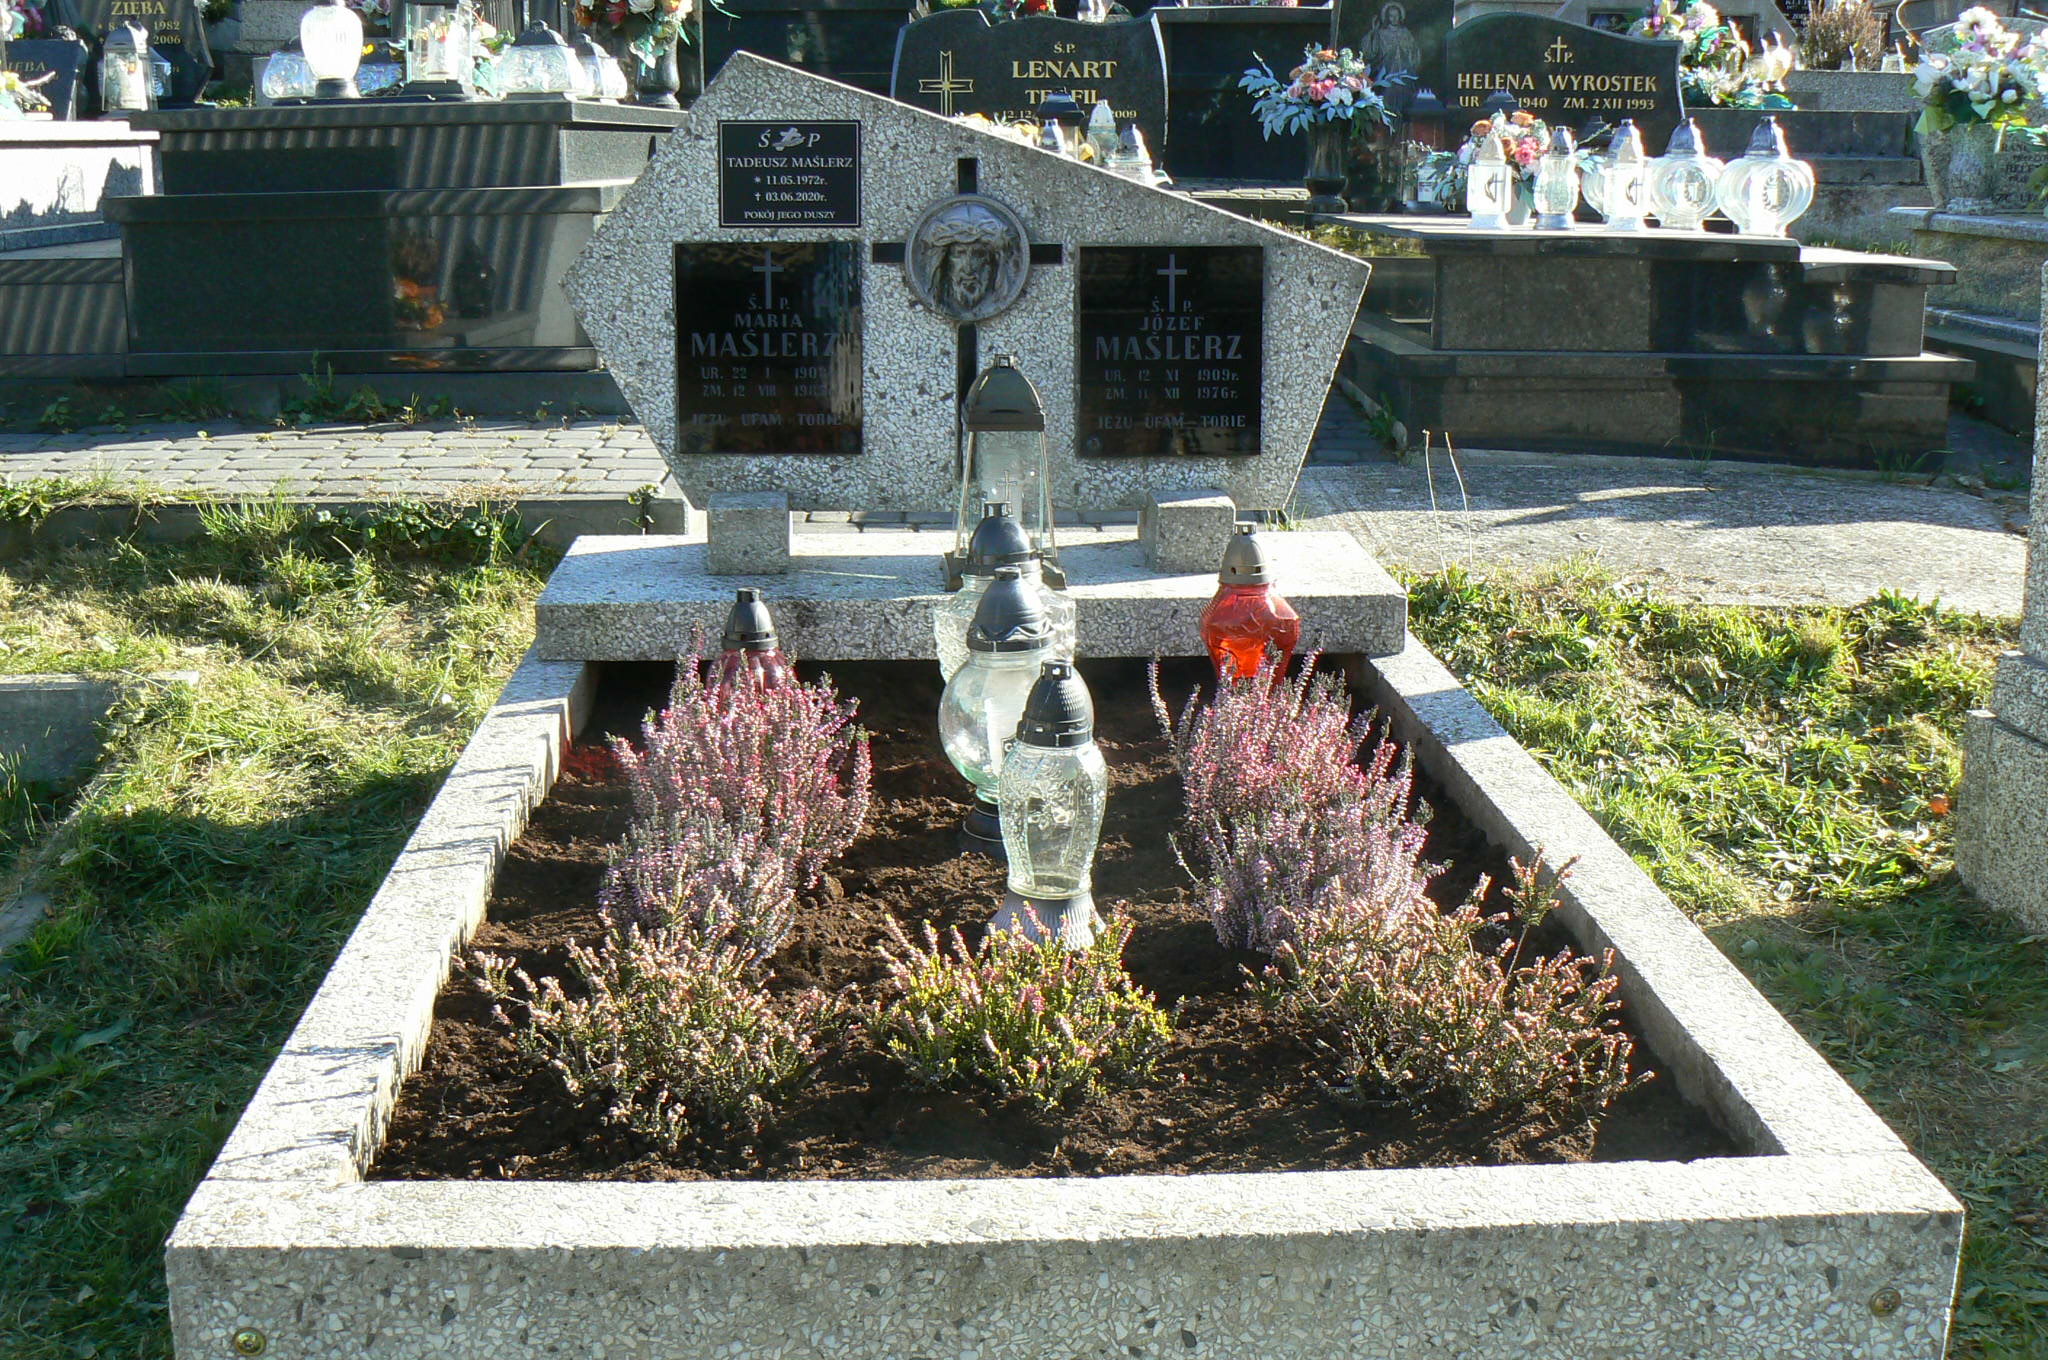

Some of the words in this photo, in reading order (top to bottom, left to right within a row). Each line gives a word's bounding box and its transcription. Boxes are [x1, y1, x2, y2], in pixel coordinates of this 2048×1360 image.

[153, 21, 181, 31] 1982
[153, 35, 182, 45] 2006
[1012, 60, 1118, 78] LENART
[1457, 73, 1535, 90] HELENA
[1548, 74, 1657, 92] WYROSTEK
[1025, 89, 1098, 104] TEFIL
[1518, 97, 1548, 109] 1940
[1563, 97, 1589, 110] ZM.
[1592, 98, 1600, 109] 2
[1602, 98, 1622, 110] XII
[1626, 98, 1655, 110] 1993
[1111, 110, 1137, 119] 009
[807, 133, 821, 148] P
[727, 157, 788, 168] TADEUSZ
[791, 155, 853, 168] MAŚLERZ
[766, 175, 828, 185] 11.05.1972r.
[765, 192, 828, 202] 03.06.2020r.
[744, 209, 775, 220] POKÓJ
[777, 211, 801, 220] JEGO
[804, 211, 835, 219] DUSZY
[735, 313, 803, 328] MARIA
[1139, 313, 1205, 331] JÓZEF
[691, 328, 841, 357] MAŚLERZ
[1096, 331, 1242, 361] MAŚLERZ
[701, 367, 724, 380] UR.
[732, 367, 747, 380] 22
[1104, 369, 1126, 382] UR.
[1138, 369, 1151, 382] 12
[1165, 369, 1179, 381] XI
[703, 384, 726, 398] ZM.
[733, 385, 745, 397] 12
[1105, 387, 1127, 400] ZM.
[1145, 415, 1185, 429] UFAM
[1201, 415, 1246, 428] TOBIE
